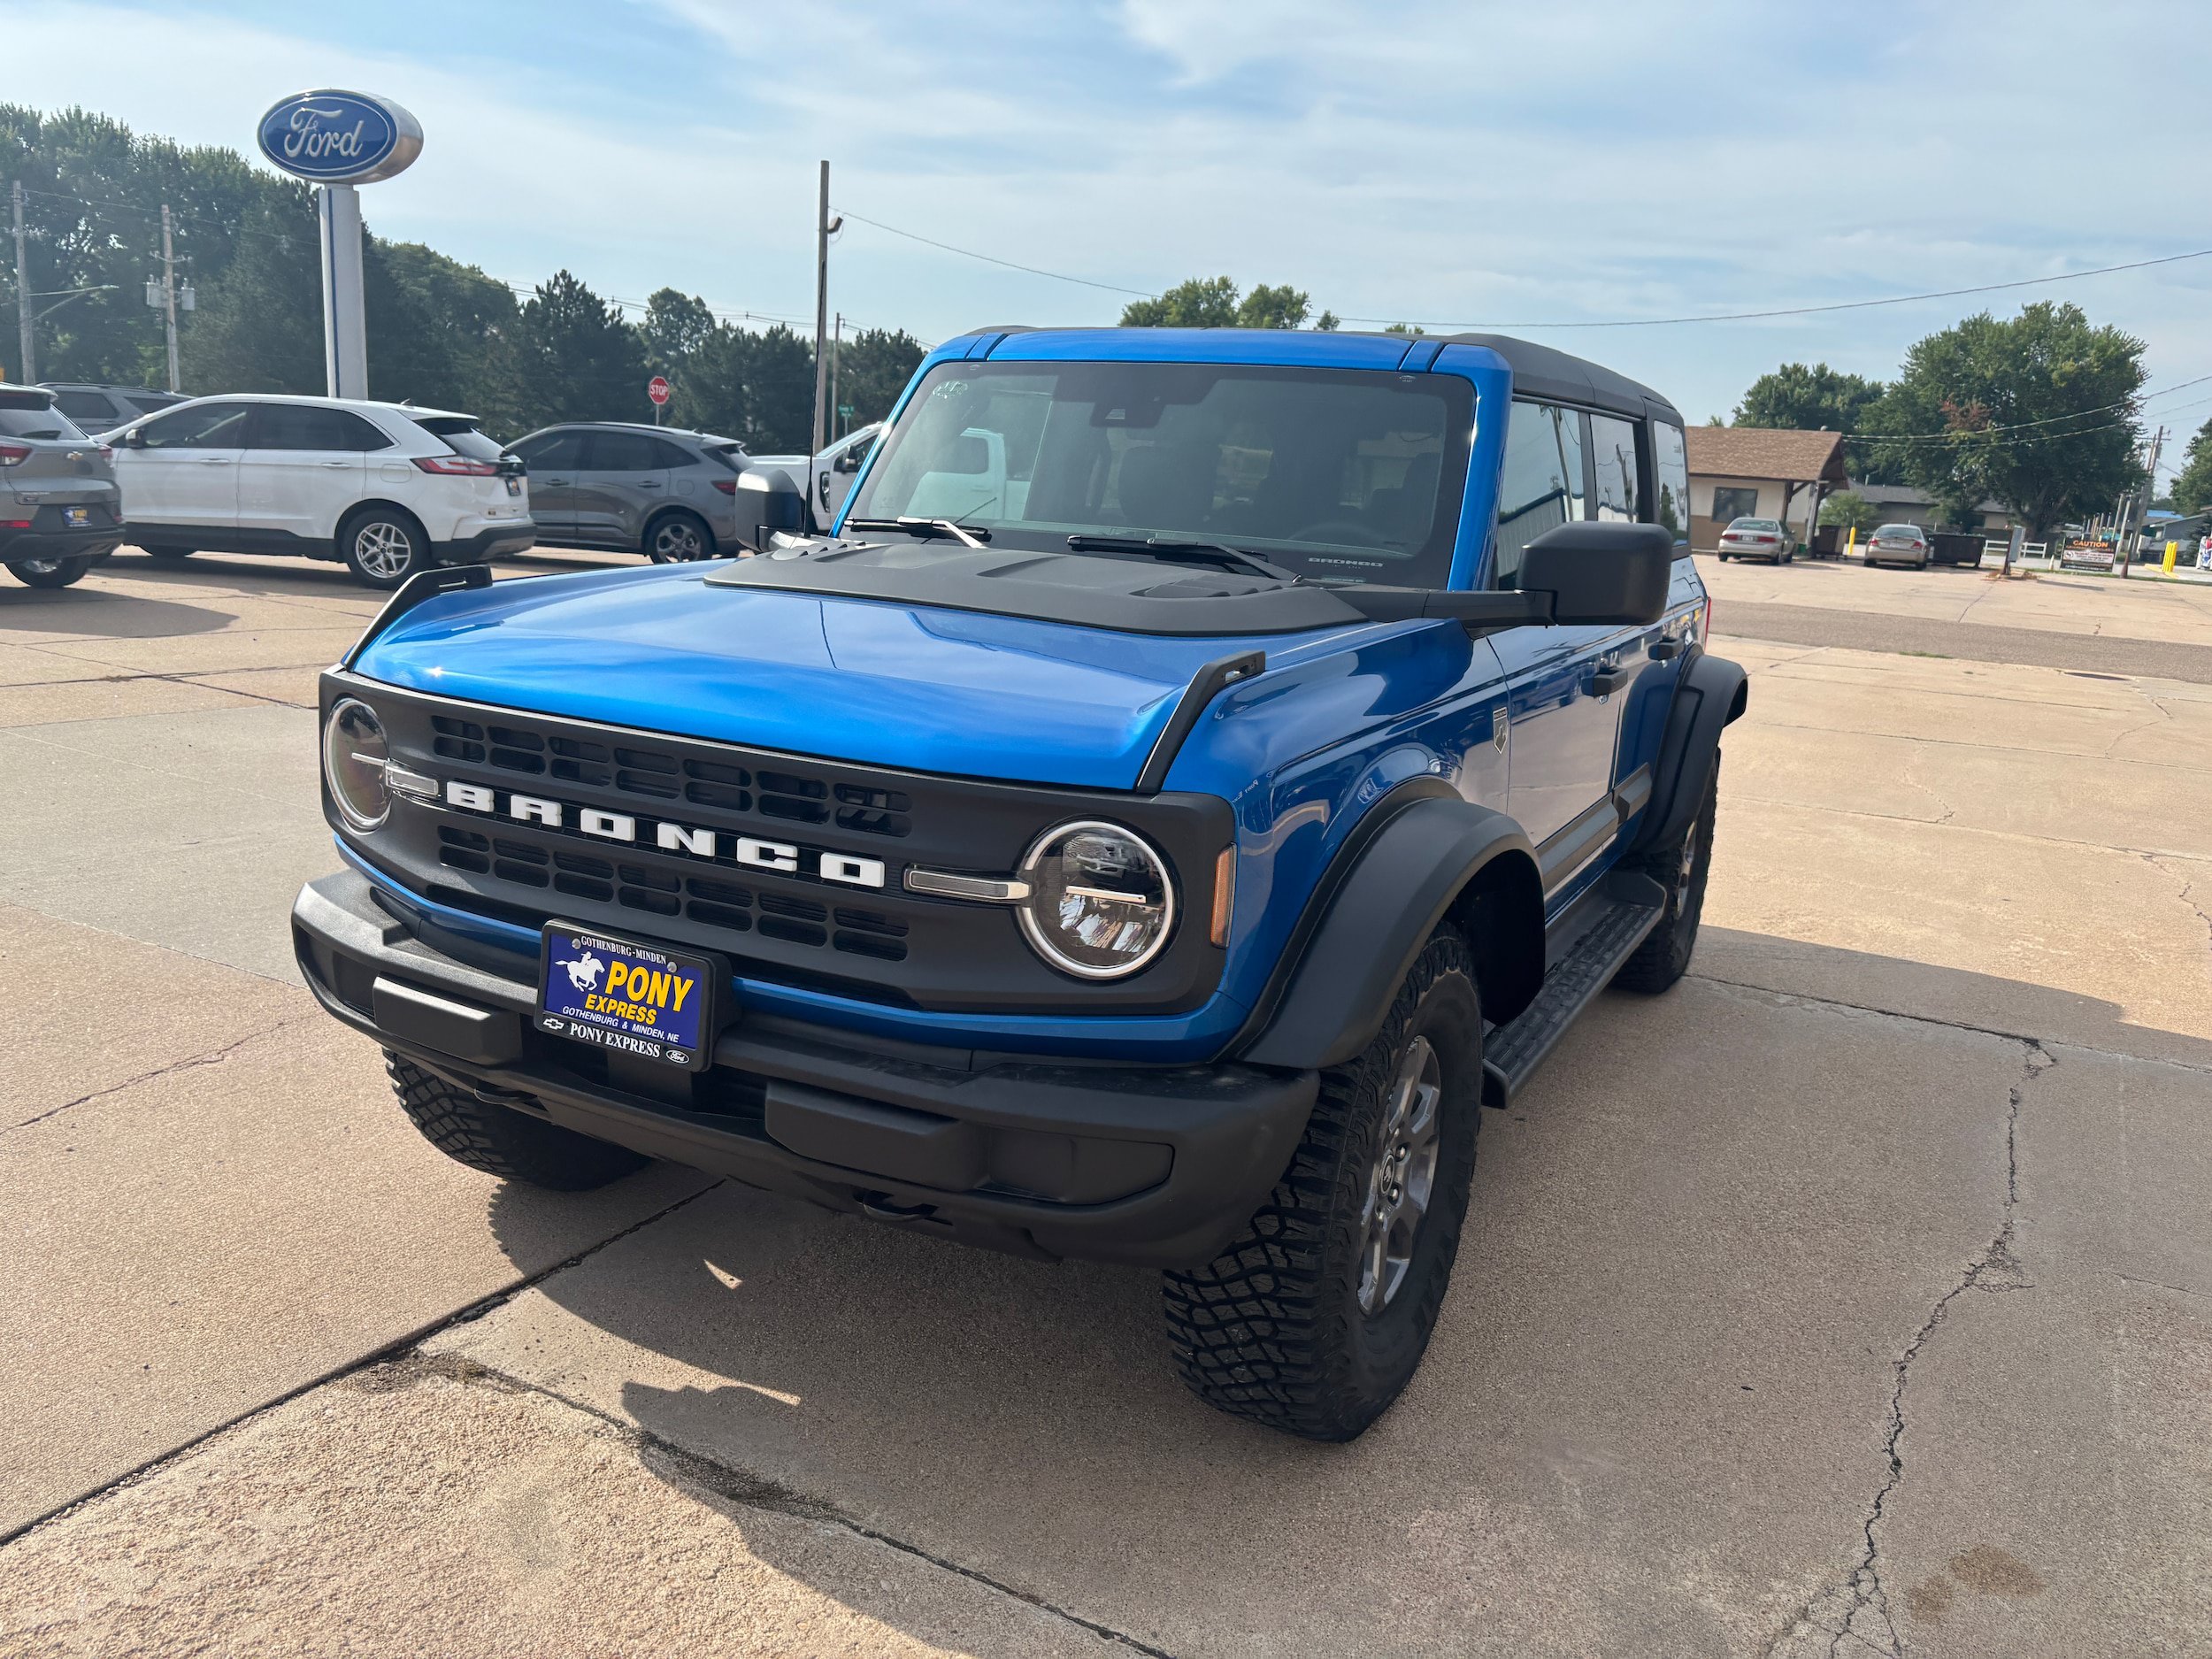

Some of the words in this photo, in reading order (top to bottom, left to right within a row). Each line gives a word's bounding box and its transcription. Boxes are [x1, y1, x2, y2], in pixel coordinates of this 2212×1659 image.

[284, 107, 365, 158] Ford
[650, 384, 668, 396] STOP
[447, 780, 885, 888] BRONCO
[605, 960, 695, 1012] PONY
[562, 1005, 619, 1027] GOTHENBURG
[621, 1020, 628, 1030] &
[631, 1023, 665, 1041] MINDEN,
[666, 1032, 680, 1043] NE
[584, 993, 657, 1025] EXPRESS
[569, 1022, 604, 1043] PONY
[605, 1032, 661, 1058] EXPRESS
